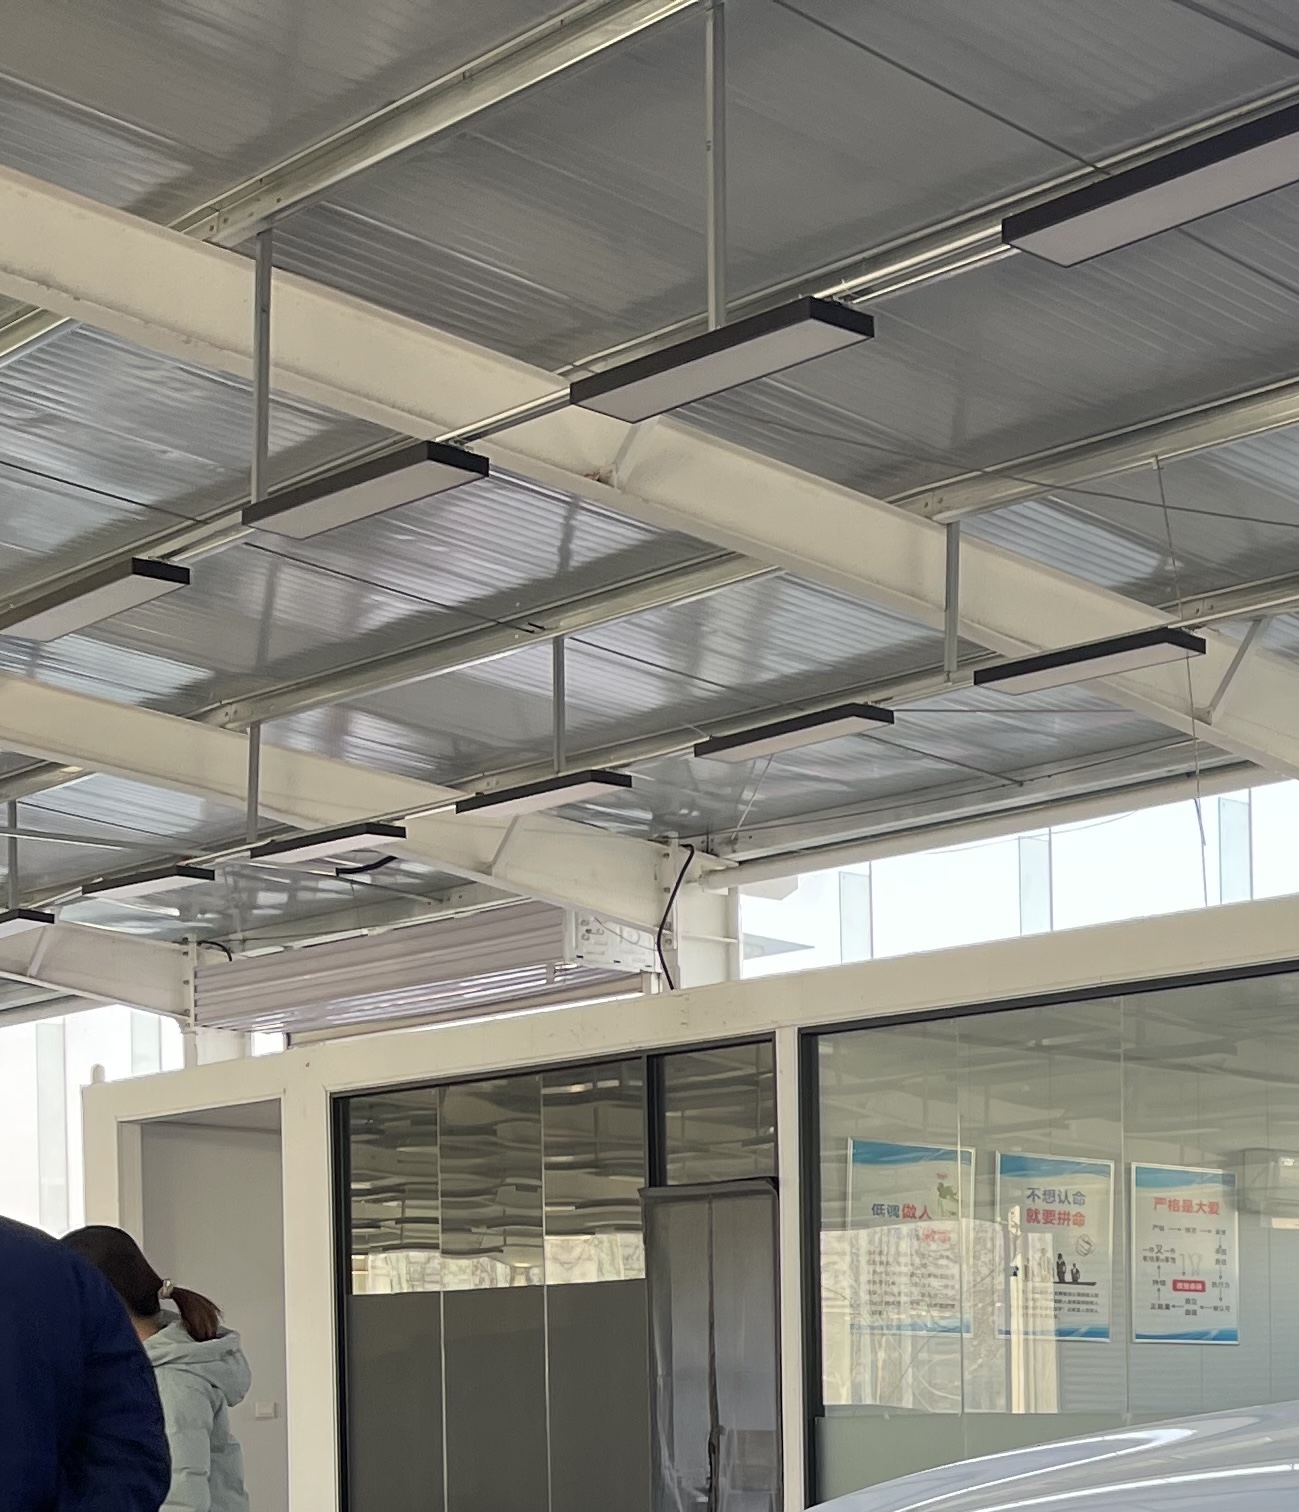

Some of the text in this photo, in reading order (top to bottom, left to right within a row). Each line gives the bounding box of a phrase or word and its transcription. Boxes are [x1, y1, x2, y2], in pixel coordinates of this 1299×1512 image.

[1025, 1187, 1087, 1206] 不想认命
[1153, 1196, 1221, 1216] 严格是大爱
[871, 1203, 932, 1220] 低调做人
[1025, 1207, 1087, 1228] 就要拼命
